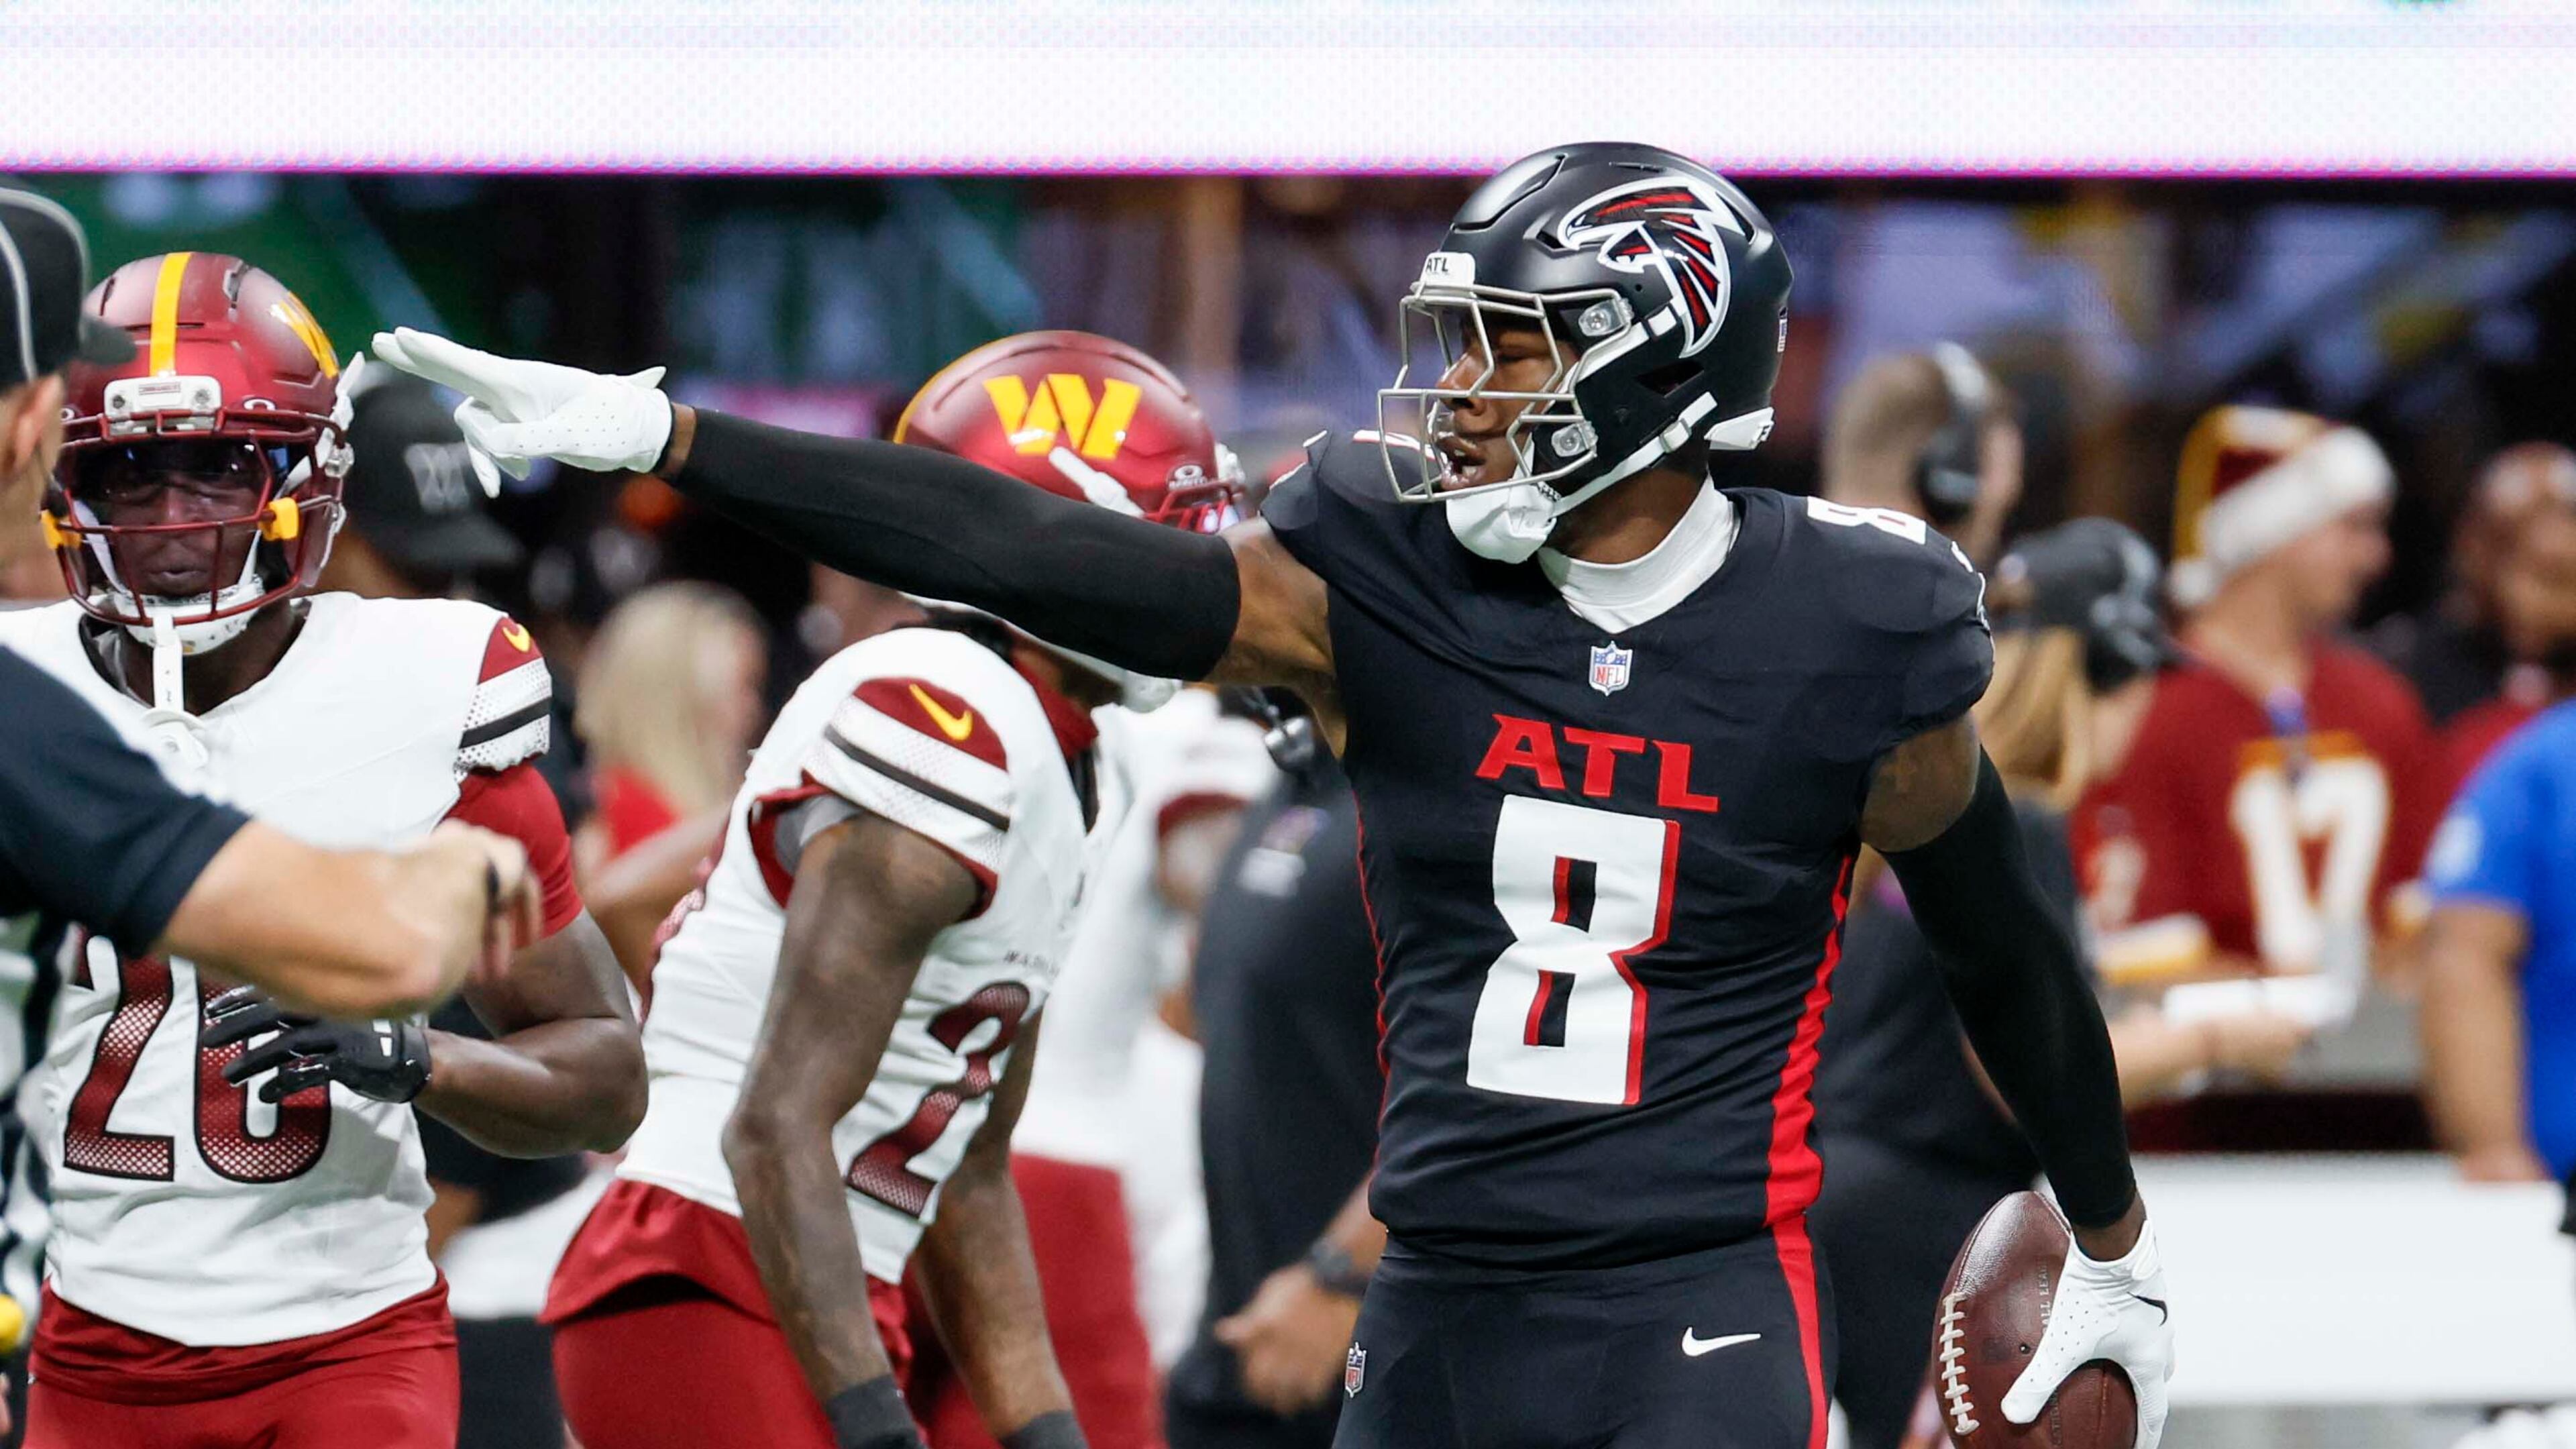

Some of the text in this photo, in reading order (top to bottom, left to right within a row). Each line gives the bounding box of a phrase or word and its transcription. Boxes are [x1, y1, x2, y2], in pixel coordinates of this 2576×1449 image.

[1426, 257, 1449, 272] ATL
[982, 373, 1143, 460] W
[1596, 665, 1622, 685] NFL
[1475, 713, 1719, 812] ATL
[1466, 794, 1681, 1106] 8
